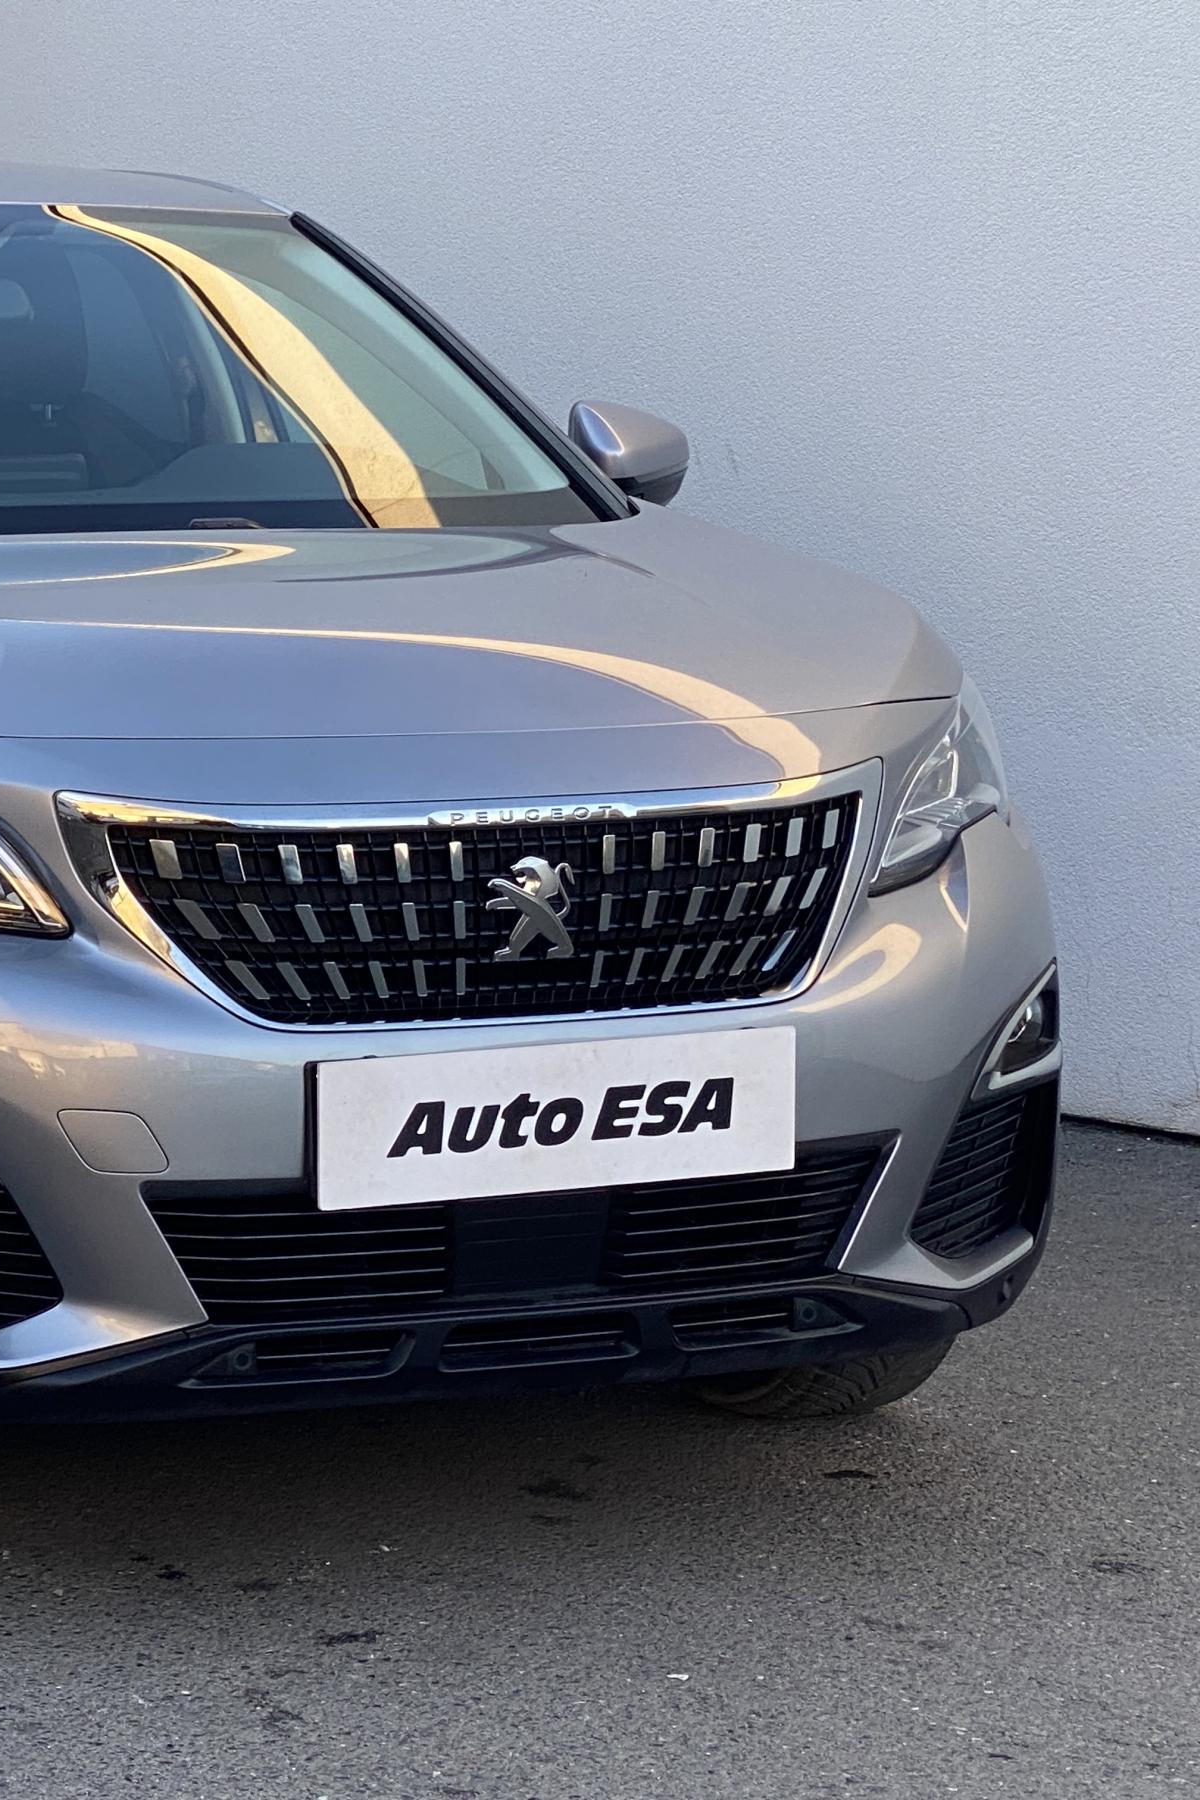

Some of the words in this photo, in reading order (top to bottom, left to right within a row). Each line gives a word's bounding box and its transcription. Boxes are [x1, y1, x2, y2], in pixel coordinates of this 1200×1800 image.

[450, 805, 612, 826] PEUGEOT
[387, 1093, 584, 1158] Auto
[592, 1077, 734, 1141] ESA
